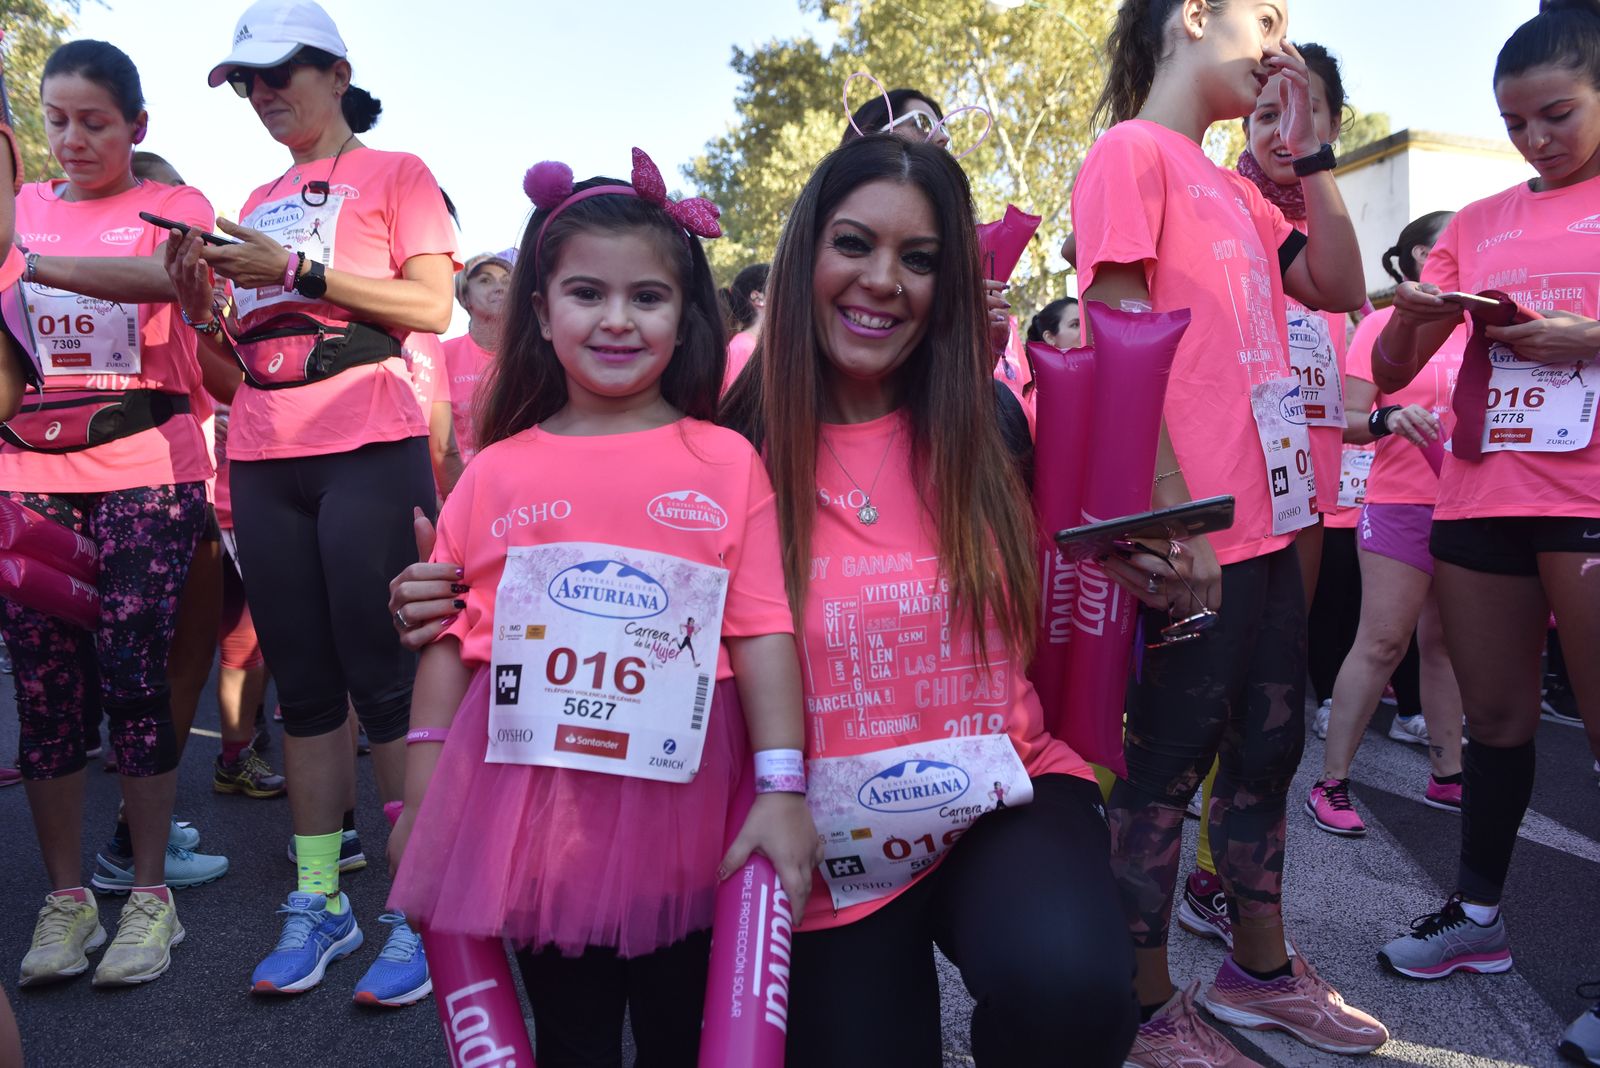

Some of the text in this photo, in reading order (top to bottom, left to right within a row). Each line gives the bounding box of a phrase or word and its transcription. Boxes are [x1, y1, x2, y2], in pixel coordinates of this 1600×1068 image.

[1477, 229, 1523, 252] OYSHO
[1541, 288, 1583, 301] GASTEIZ
[38, 314, 95, 335] 016
[52, 339, 81, 349] 7309
[86, 374, 130, 390] 2019
[1531, 368, 1563, 377] Carrera
[1487, 387, 1545, 410] 016
[1492, 413, 1524, 424] 4778
[491, 499, 572, 538] OYSHO
[654, 502, 721, 527] ASTURIANA
[1278, 505, 1301, 521] OYSHO
[842, 552, 913, 578] GANAN
[555, 577, 659, 610] ASTURIANA
[865, 581, 925, 602] VITORIA
[625, 622, 670, 642] Carrera
[634, 638, 643, 648] de
[648, 640, 680, 664] Mujer
[869, 648, 893, 665] LEN
[545, 647, 647, 695] 016
[871, 664, 892, 679] CIA
[905, 655, 937, 676] LAS
[915, 671, 1008, 708] CHICAS
[563, 697, 616, 721] 5627
[807, 691, 882, 713] BARCELONA
[497, 728, 534, 743] OYSHO
[870, 714, 918, 736] CORUÑA
[944, 712, 1005, 739] 2019
[576, 736, 619, 750] Santander
[649, 757, 684, 770] ZURICH
[868, 777, 964, 806] ASTURIANA
[939, 804, 982, 819] Carrera
[842, 881, 893, 893] OYSHO
[731, 865, 754, 1019] TRIPLE PROTECCIÓN SOLAR
